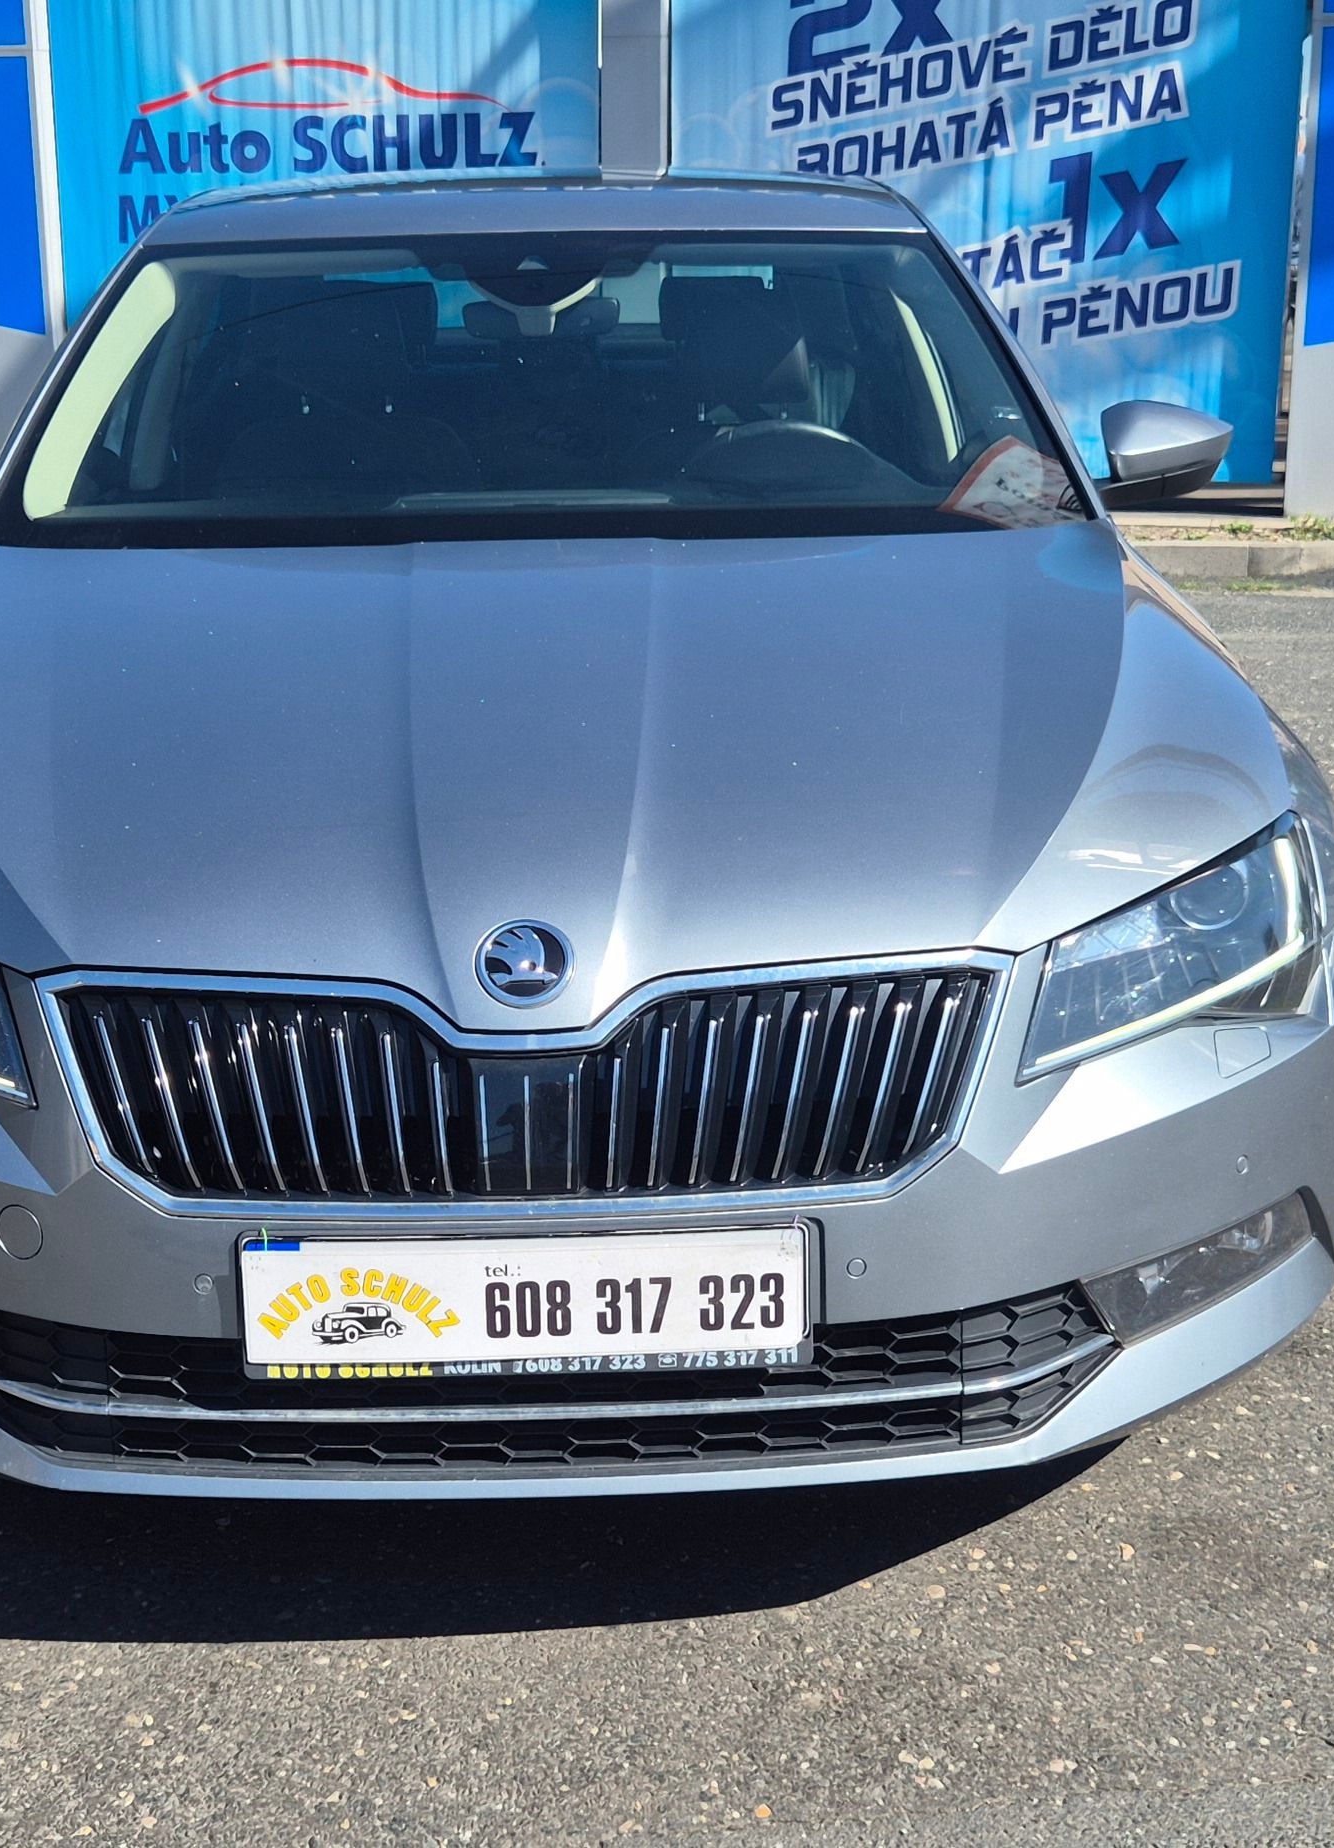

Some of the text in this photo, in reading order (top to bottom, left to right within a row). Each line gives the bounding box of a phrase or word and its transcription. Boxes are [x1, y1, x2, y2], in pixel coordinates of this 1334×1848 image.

[771, 0, 1192, 130] SNĚHOVÉ DĚLO
[1034, 68, 1182, 143] PĚNA
[119, 112, 538, 174] Auto SCHULZ
[1041, 267, 1235, 345] PĚNOU
[257, 1267, 460, 1340] AUTO SCHULZ
[484, 1264, 521, 1278] tel.:
[485, 1272, 784, 1339] 608 317 323
[525, 1357, 563, 1373] 608
[568, 1355, 603, 1371] 317
[609, 1353, 646, 1370] 323
[683, 1350, 718, 1368] 775
[724, 1348, 756, 1367] 317
[764, 1345, 798, 1364] 311
